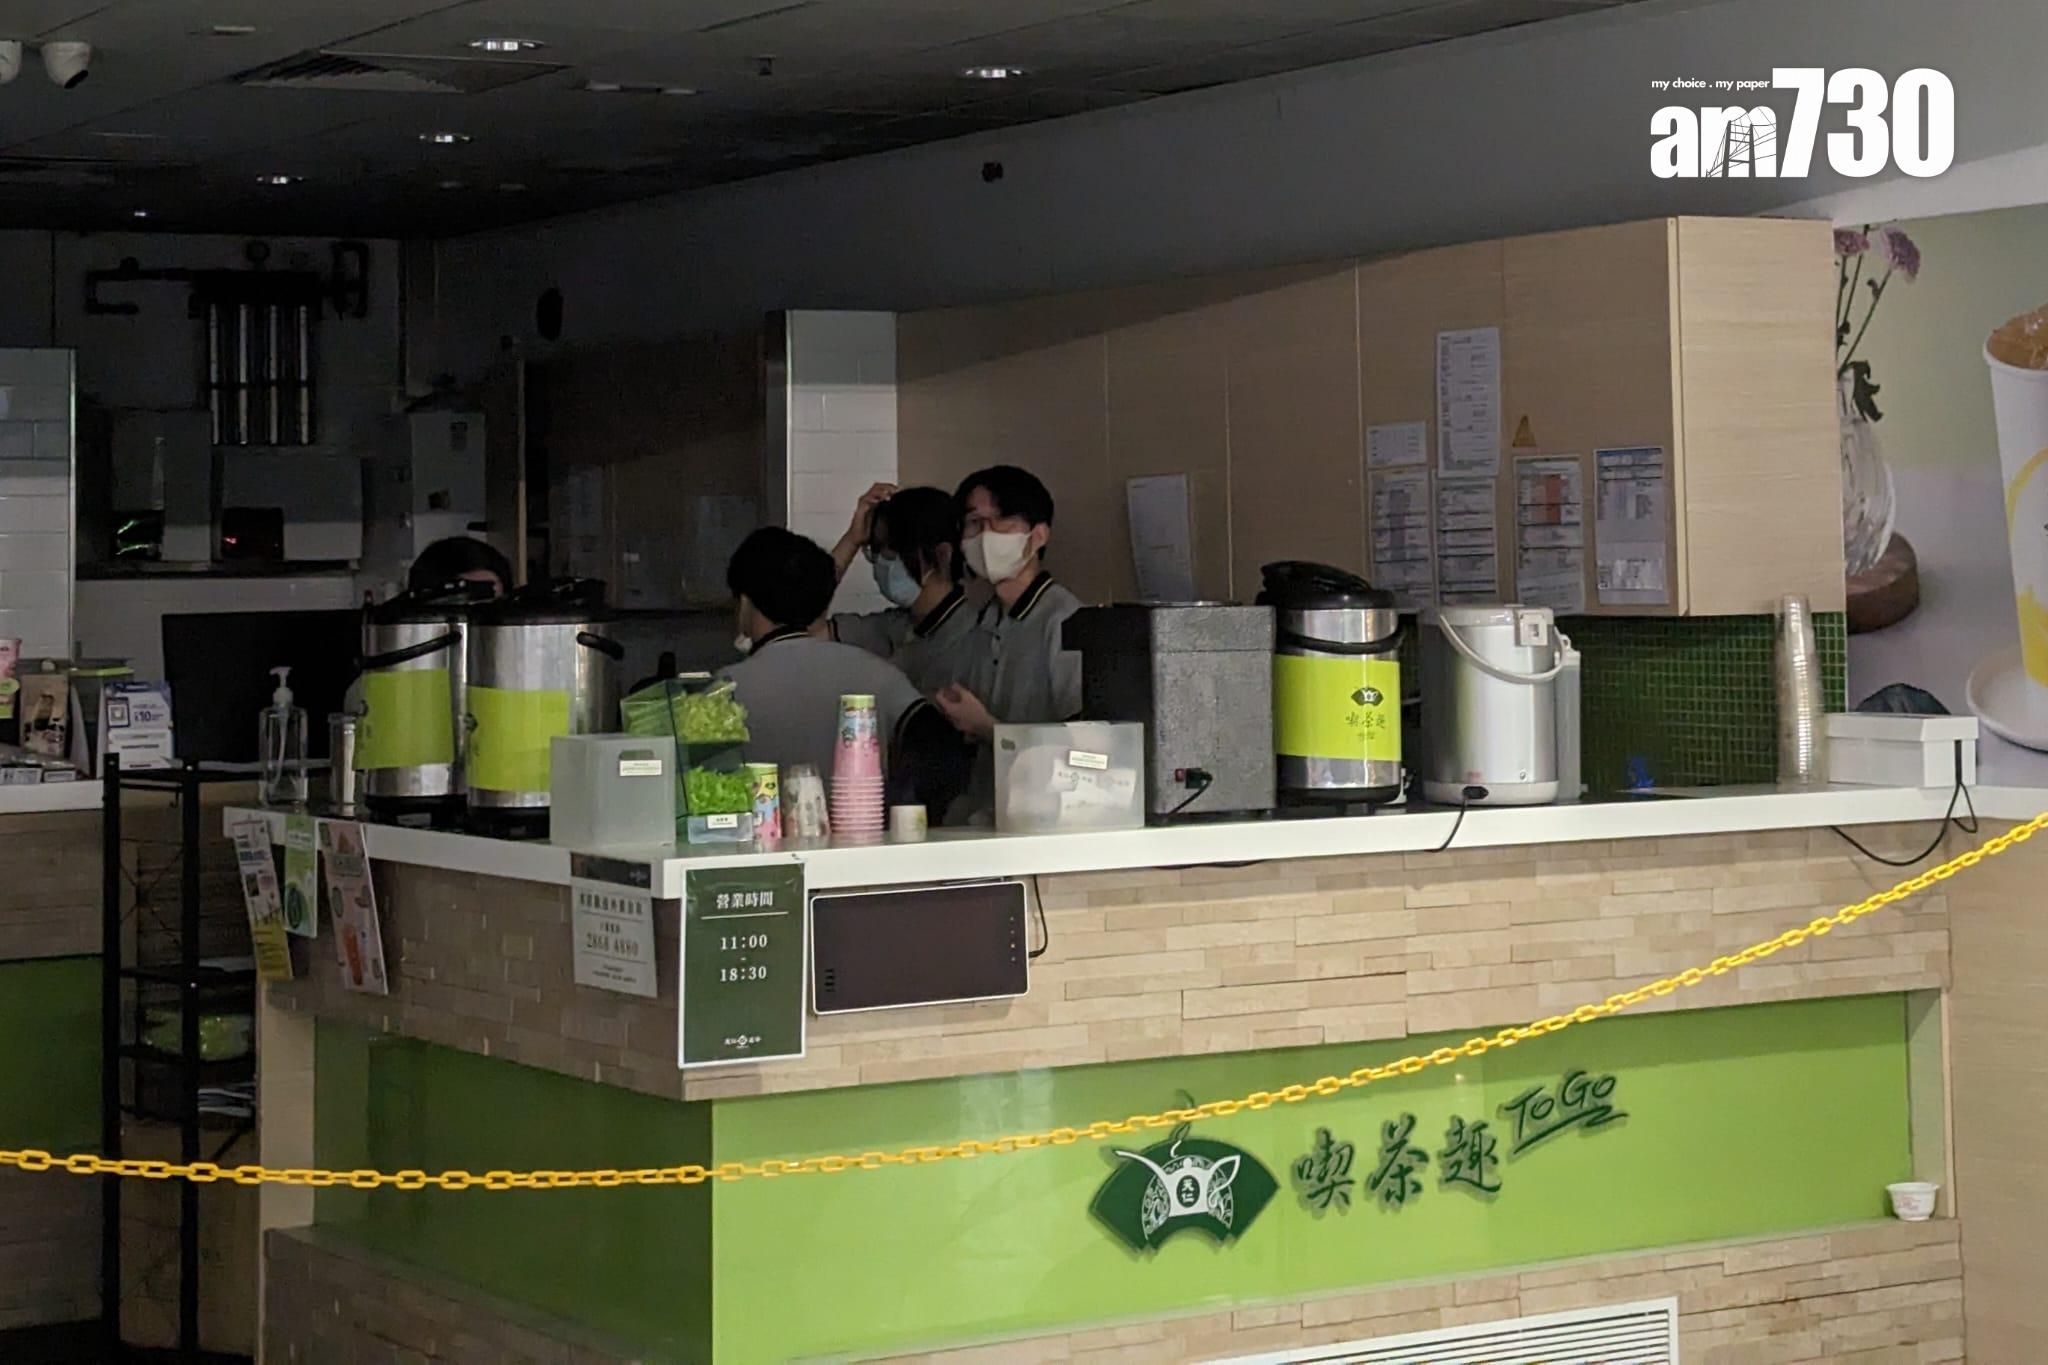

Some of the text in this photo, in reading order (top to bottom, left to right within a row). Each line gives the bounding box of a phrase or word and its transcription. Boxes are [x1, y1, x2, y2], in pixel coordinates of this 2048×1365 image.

[716, 891, 774, 909] 營業時間
[720, 934, 768, 950] 11:00
[720, 966, 767, 982] 18:30
[1297, 1114, 1502, 1209] 喫茶趣
[1181, 1178, 1195, 1203] 天仁
